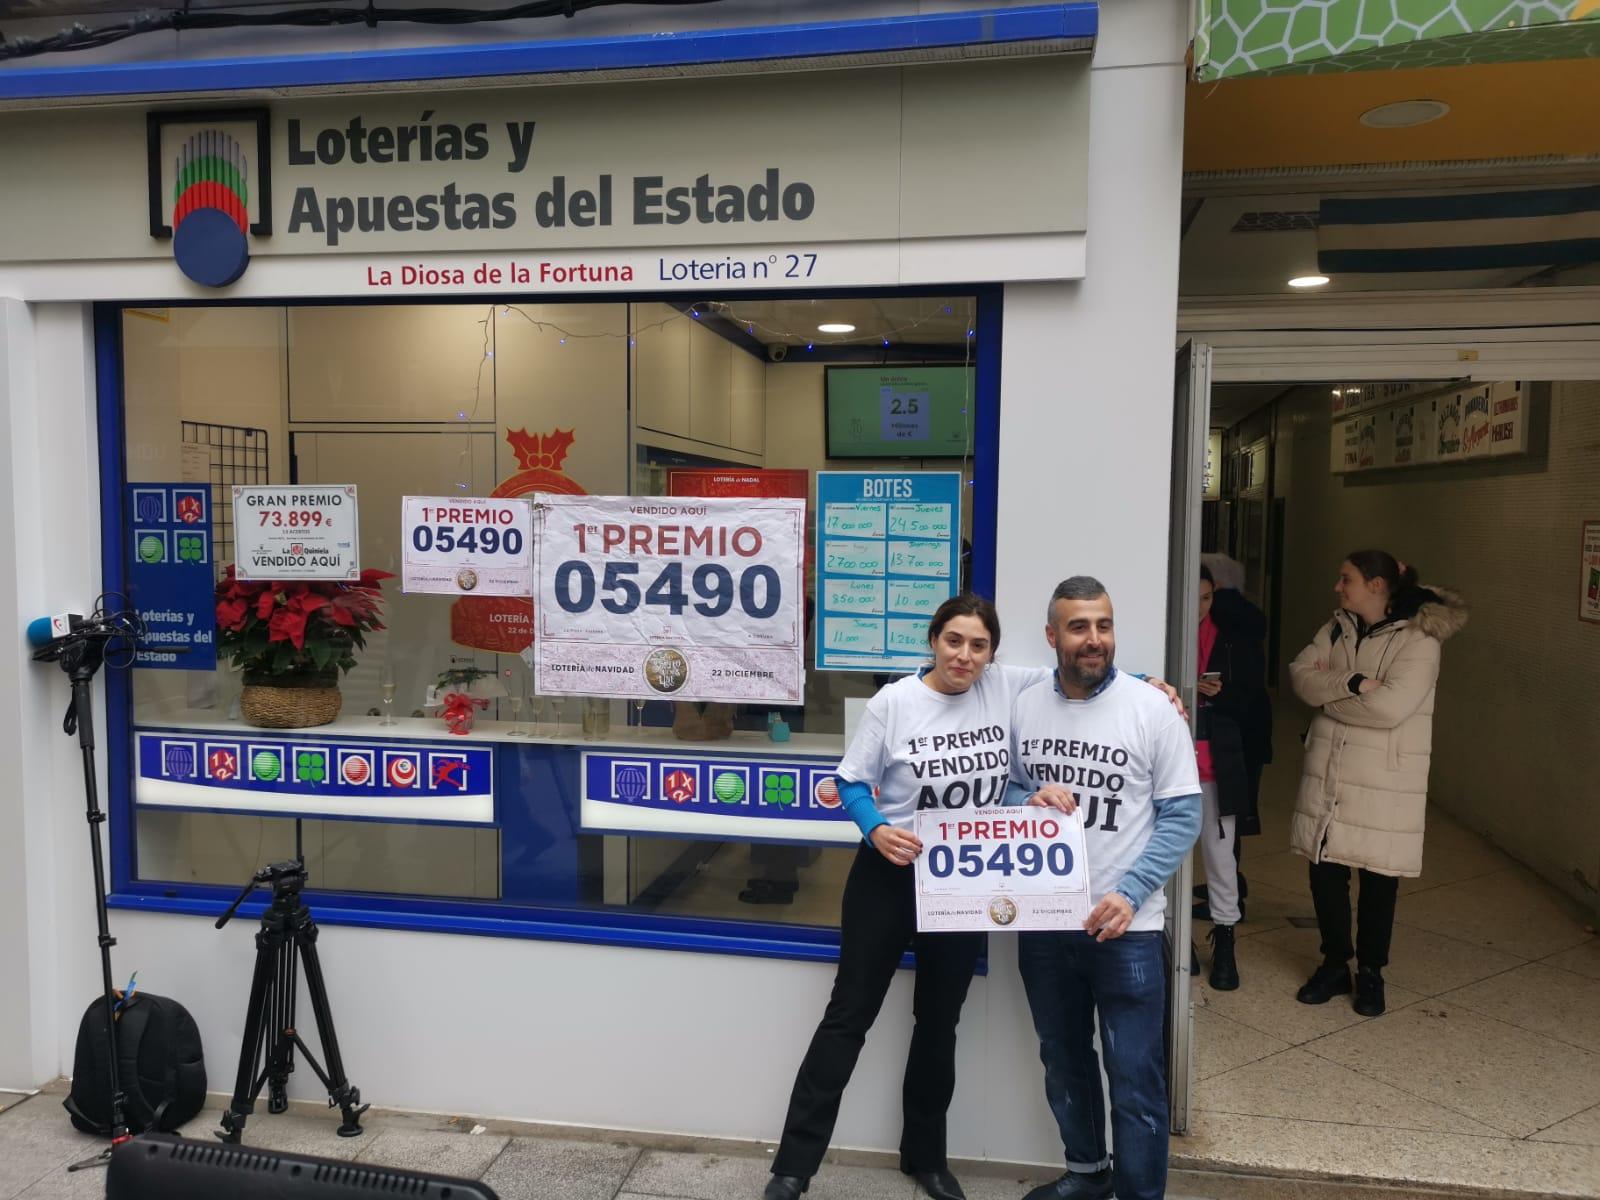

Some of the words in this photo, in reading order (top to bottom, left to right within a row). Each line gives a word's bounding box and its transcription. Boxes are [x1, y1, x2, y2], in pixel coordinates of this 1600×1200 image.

[288, 111, 489, 165] Loterías
[506, 121, 536, 173] y
[288, 182, 516, 246] Apuestas
[535, 174, 612, 228] del
[633, 168, 815, 226] Estado
[367, 266, 392, 286] La
[402, 264, 465, 285] Diosa
[473, 263, 502, 284] de
[511, 262, 530, 283] la
[540, 263, 633, 283] Fortuna
[659, 256, 746, 281] Loteria
[785, 254, 817, 278] 27
[890, 399, 919, 415] 2.5
[863, 478, 912, 498] BOTES
[247, 495, 287, 507] GRAN
[292, 495, 342, 507] PREMIO
[629, 505, 677, 516] VENDIDO
[680, 505, 707, 516] AQUÍ
[259, 510, 322, 528] 73.899
[325, 518, 333, 528] €
[436, 507, 514, 525] PREMIO
[412, 525, 523, 555] 05490
[603, 524, 763, 557] PREMIO
[253, 556, 306, 567] VENDIDO
[310, 554, 341, 567] AQUÍ
[554, 559, 782, 619] 05490
[187, 612, 195, 626] y
[489, 612, 530, 624] LOTERÍA
[193, 630, 213, 644] del
[551, 663, 586, 673] LOTERÍA
[595, 664, 635, 674] NAVIDAD
[712, 669, 723, 677] 22
[725, 669, 775, 679] DICIEMBRE
[932, 725, 1005, 752] PREMIO
[1042, 738, 1129, 767] PREMIO
[910, 748, 1009, 779] VENDIDO
[1023, 763, 1125, 793] VENDIDO
[958, 819, 1060, 840] PREMIO
[928, 843, 1074, 878] 05490
